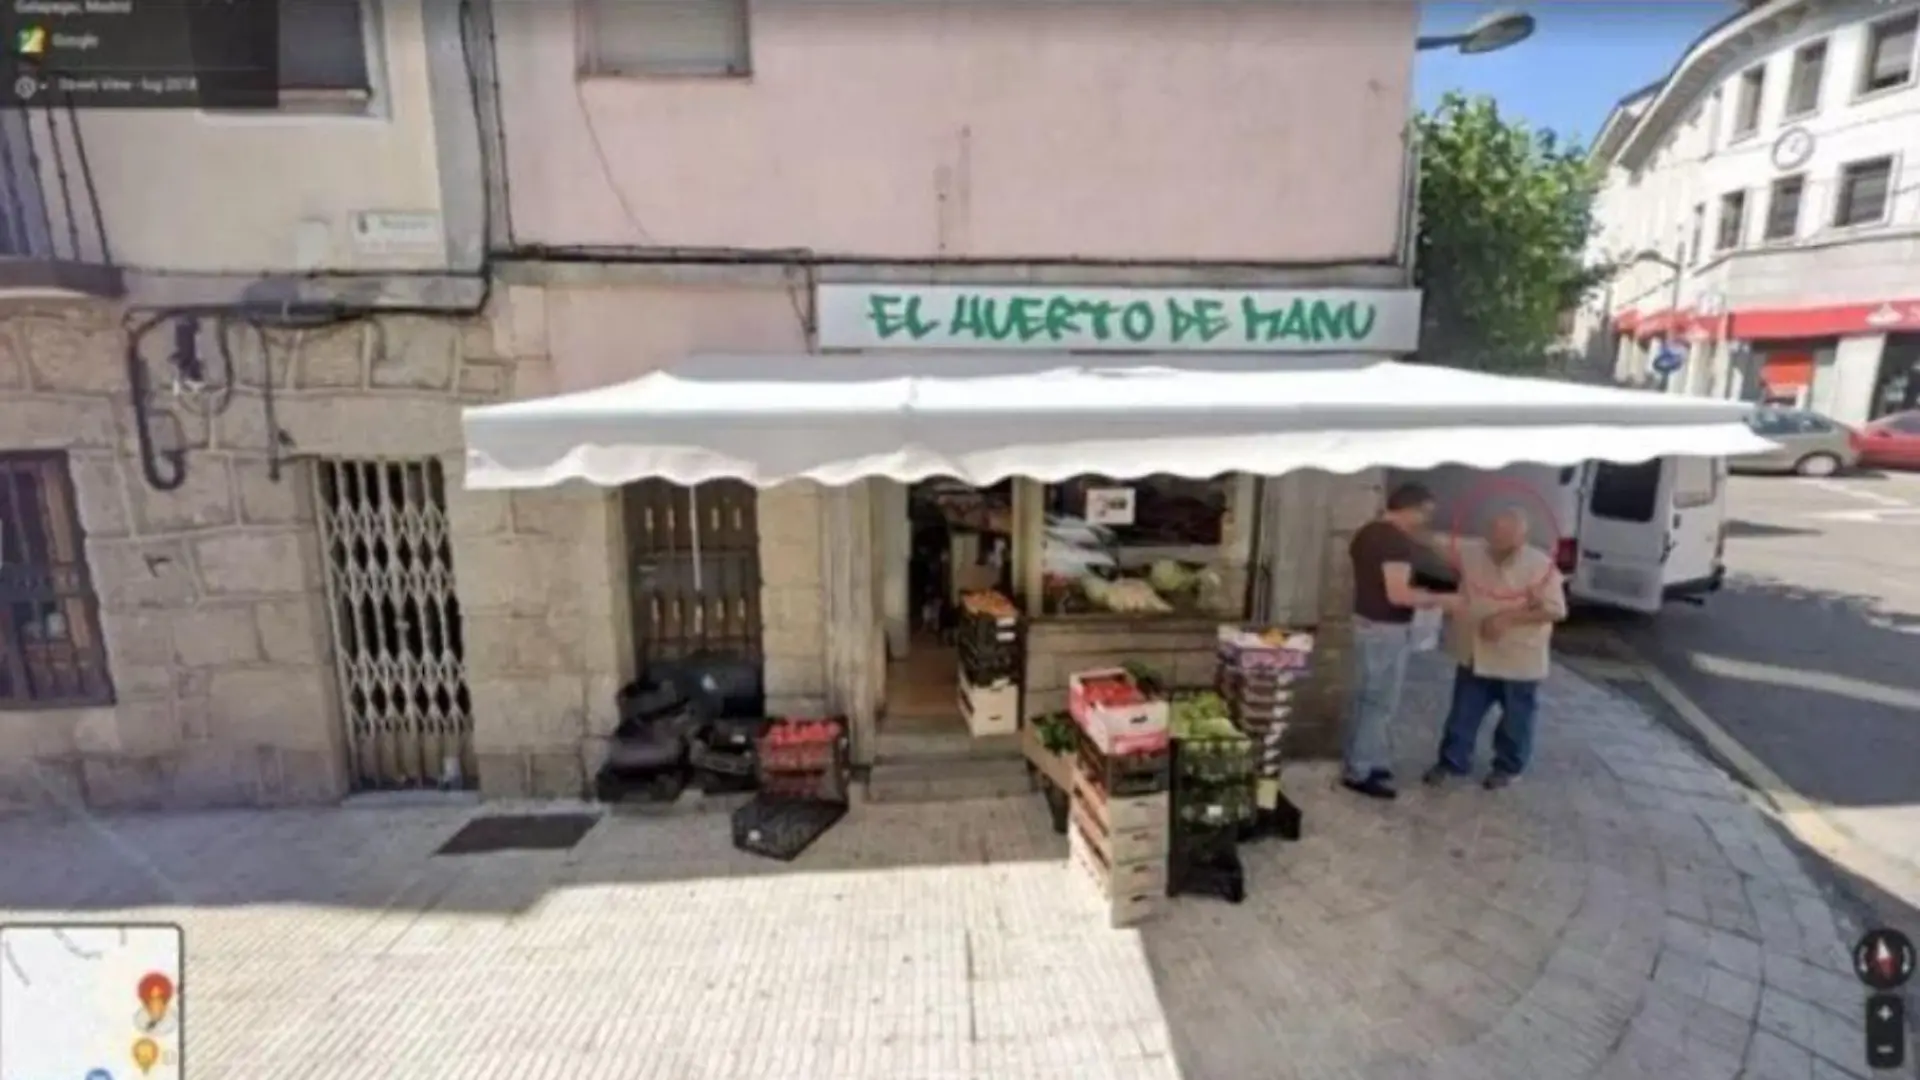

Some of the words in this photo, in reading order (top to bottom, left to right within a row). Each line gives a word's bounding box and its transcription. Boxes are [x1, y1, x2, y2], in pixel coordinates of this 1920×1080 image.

[867, 294, 938, 338] EL
[949, 293, 1155, 342] HUERTO
[1167, 299, 1230, 341] DE
[1244, 300, 1376, 342] MANU
